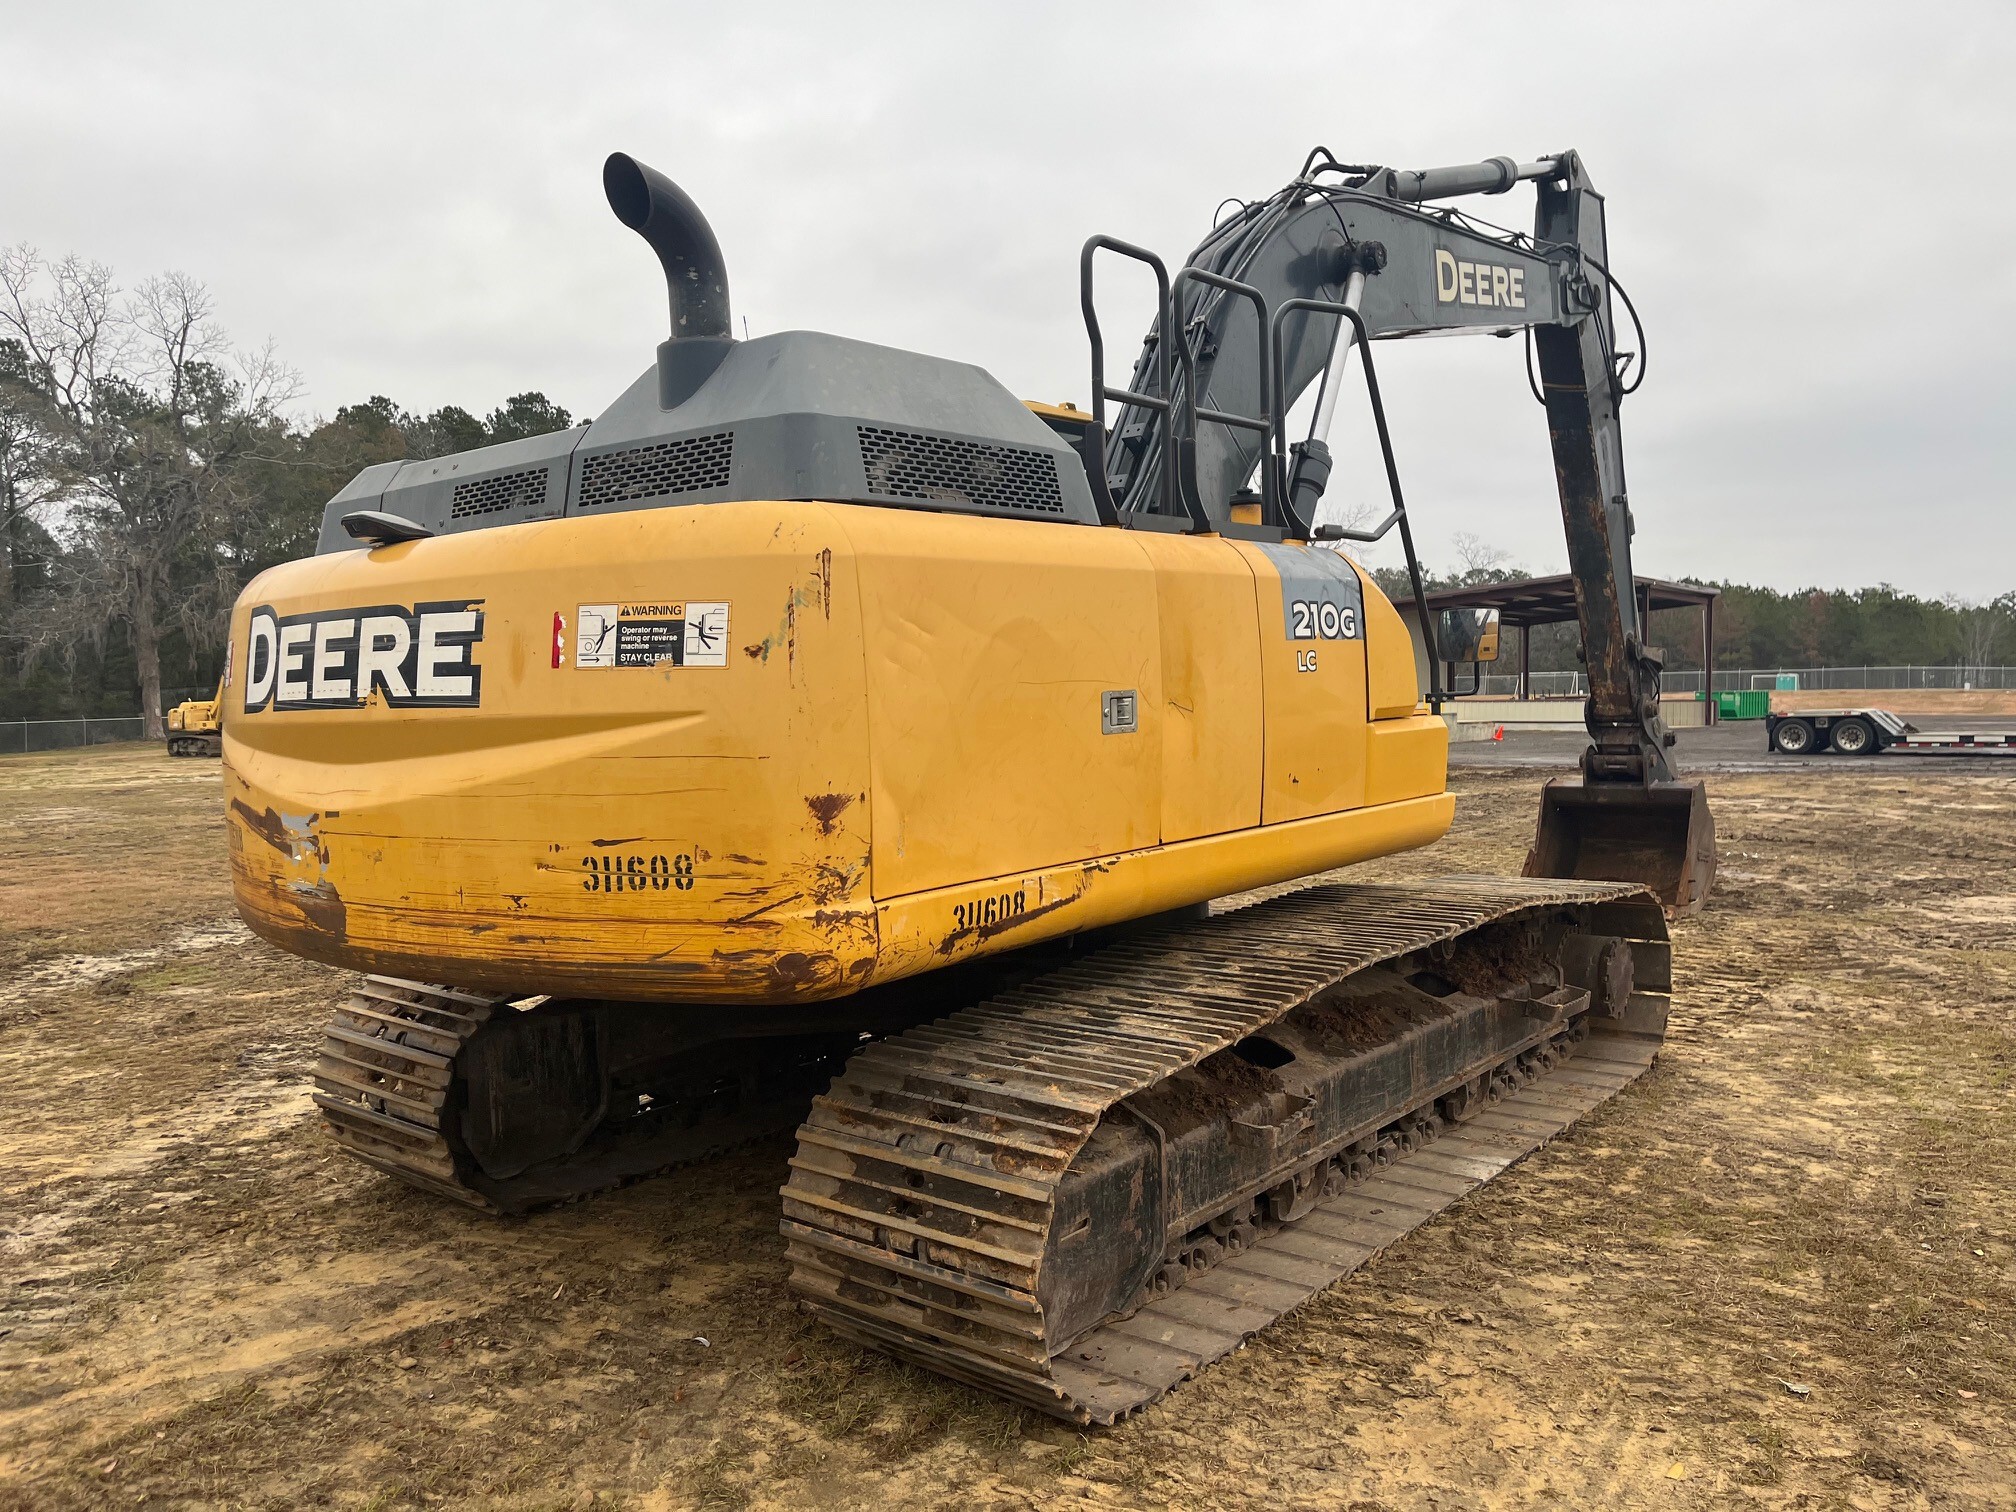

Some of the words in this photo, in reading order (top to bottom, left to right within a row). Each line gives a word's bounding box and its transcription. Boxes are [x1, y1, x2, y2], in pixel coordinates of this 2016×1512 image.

[1435, 249, 1526, 308] DEERE
[631, 605, 682, 616] WARNING
[1292, 601, 1356, 639] 210G
[621, 627, 651, 635] Operator
[621, 635, 642, 643] swing
[651, 634, 678, 642] reverse
[246, 610, 477, 704] DEERE
[620, 653, 642, 662] STAY
[643, 653, 673, 662] CLEAR
[1297, 650, 1317, 672] LC
